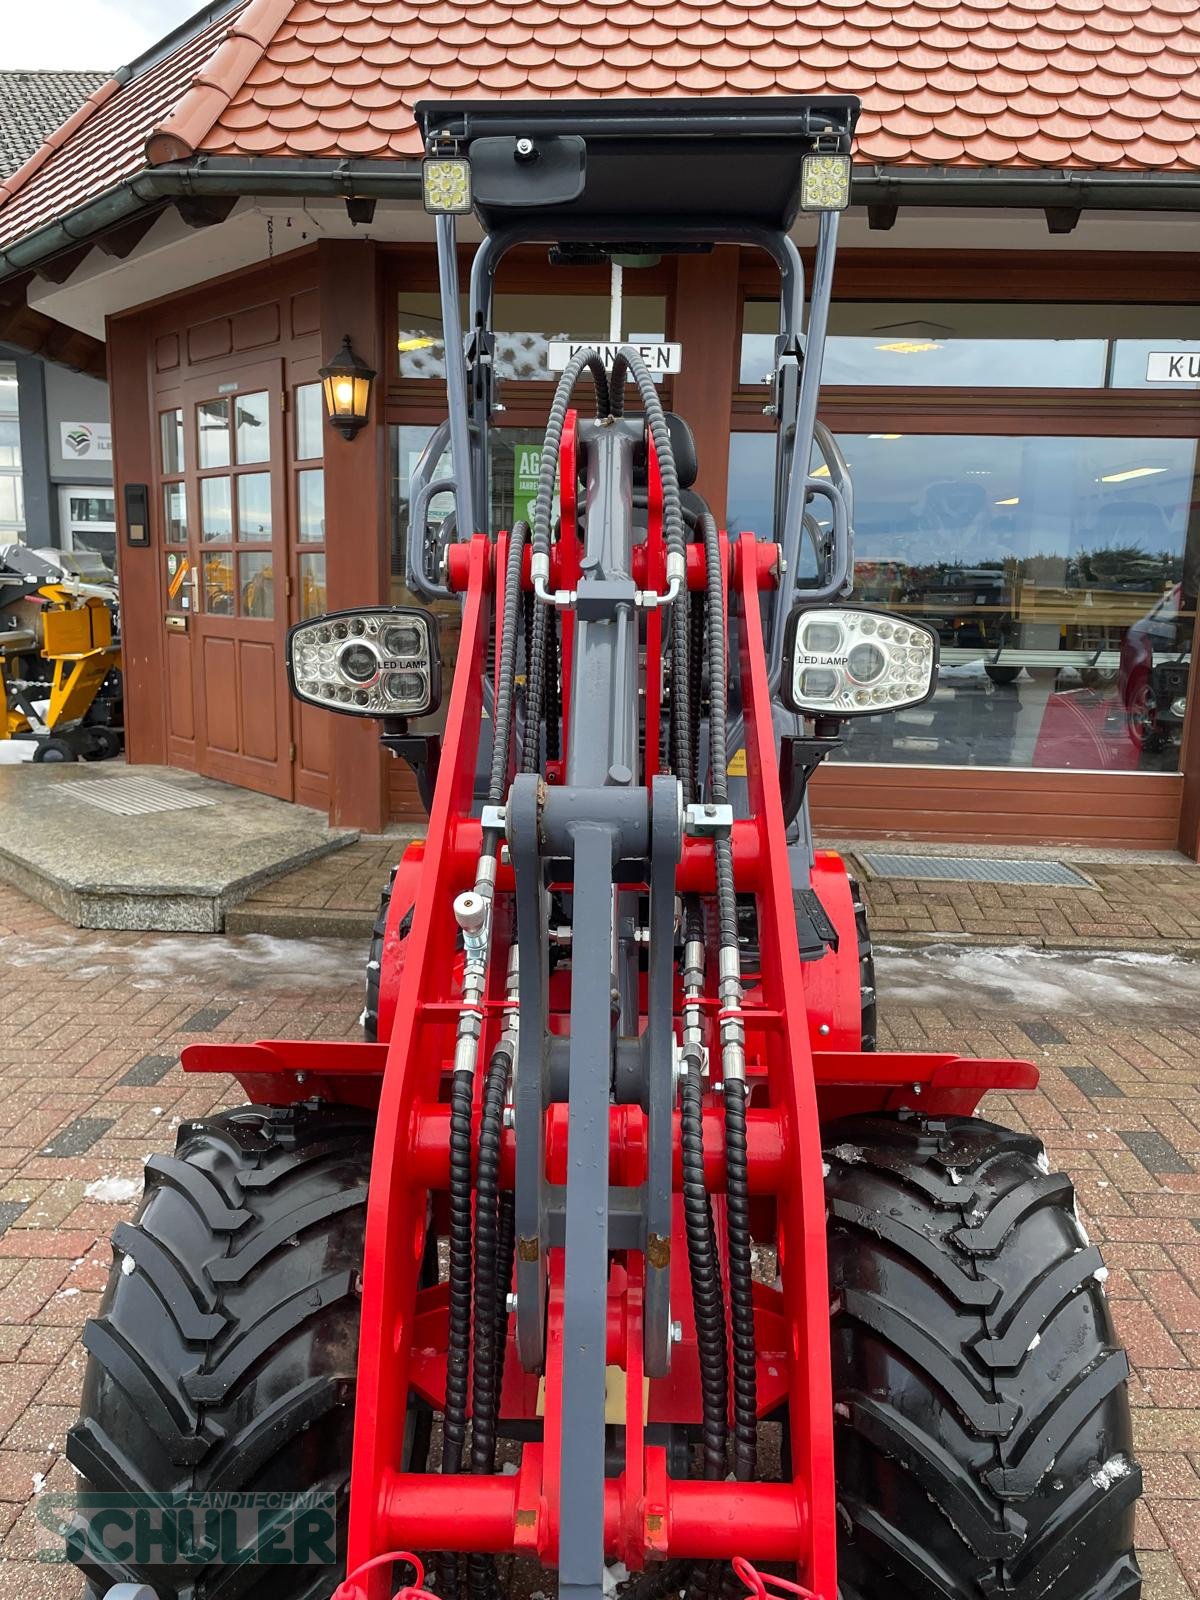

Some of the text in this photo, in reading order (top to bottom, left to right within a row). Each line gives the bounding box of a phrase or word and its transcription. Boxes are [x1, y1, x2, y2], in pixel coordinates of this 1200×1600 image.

[377, 661, 427, 669] LED LAMP
[798, 655, 849, 666] LED LAMP
